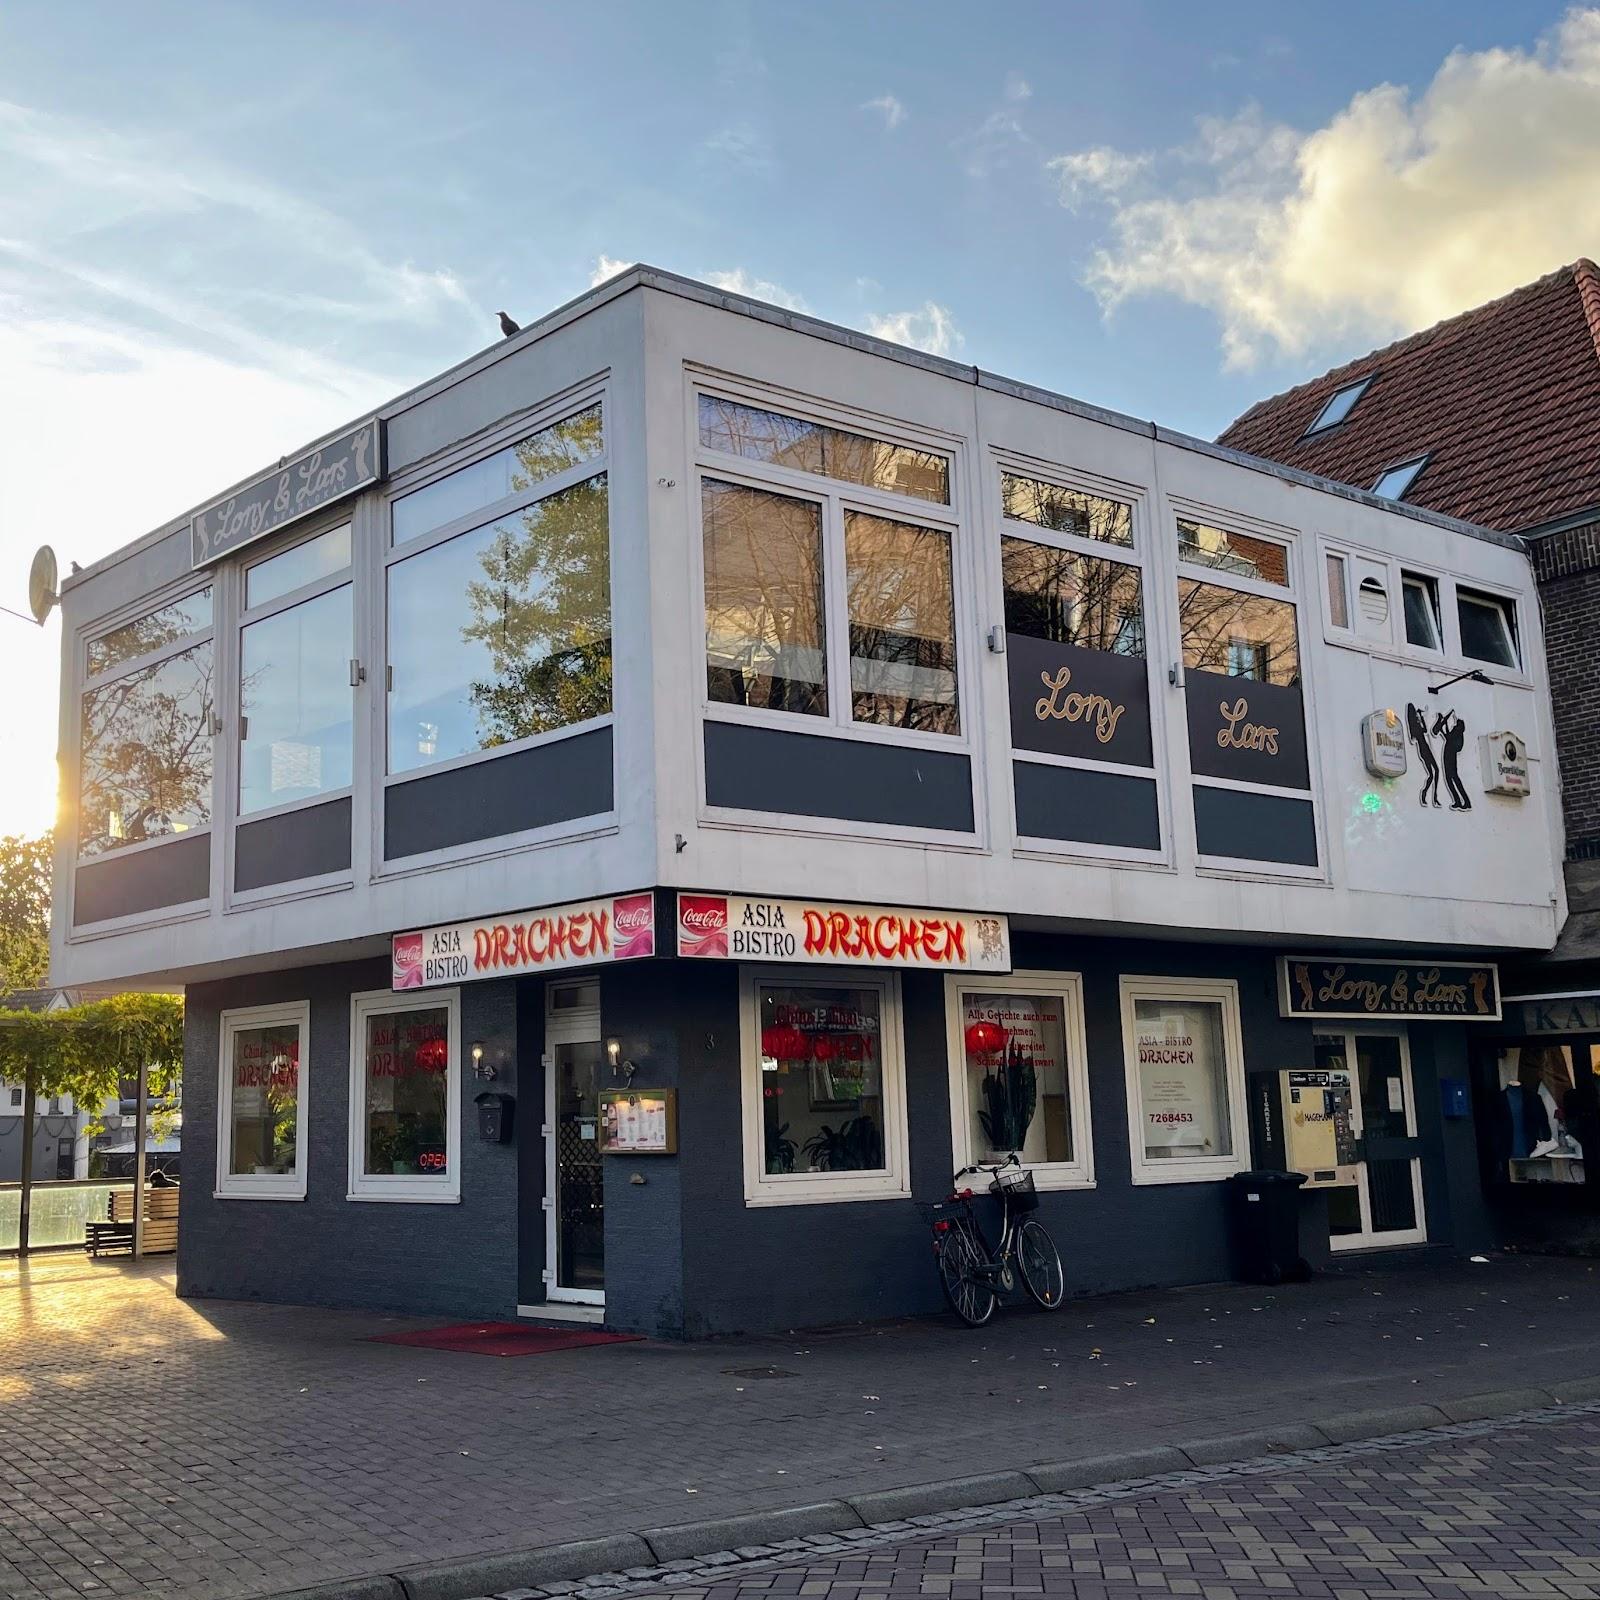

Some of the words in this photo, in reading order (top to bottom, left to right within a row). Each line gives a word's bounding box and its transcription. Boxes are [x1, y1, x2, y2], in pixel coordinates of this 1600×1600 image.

[214, 499, 272, 546] Lony
[296, 451, 349, 501] Lars
[1035, 666, 1126, 744] Lony
[1217, 697, 1280, 756] Lars
[741, 903, 786, 928] ASIA
[431, 930, 462, 954] ASIA
[473, 908, 610, 973] DRACHEN
[732, 930, 796, 957] BISTRO
[803, 907, 967, 964] DRACHEN
[426, 955, 469, 980] BISTRO
[1318, 965, 1388, 1012] Lony
[1413, 967, 1468, 1004] Lars
[968, 1009, 985, 1019] Alle
[987, 1009, 1020, 1020] Gerichte
[1023, 1011, 1040, 1022] auch
[1042, 1014, 1057, 1022] zum
[1381, 1003, 1467, 1013] ABENDLOKAL
[1536, 1004, 1600, 1030] KA
[1139, 1037, 1158, 1046] ASIA
[1165, 1036, 1193, 1046] BISTRO
[1139, 1049, 1194, 1064] DRACHEN
[1149, 1113, 1193, 1123] 7268453
